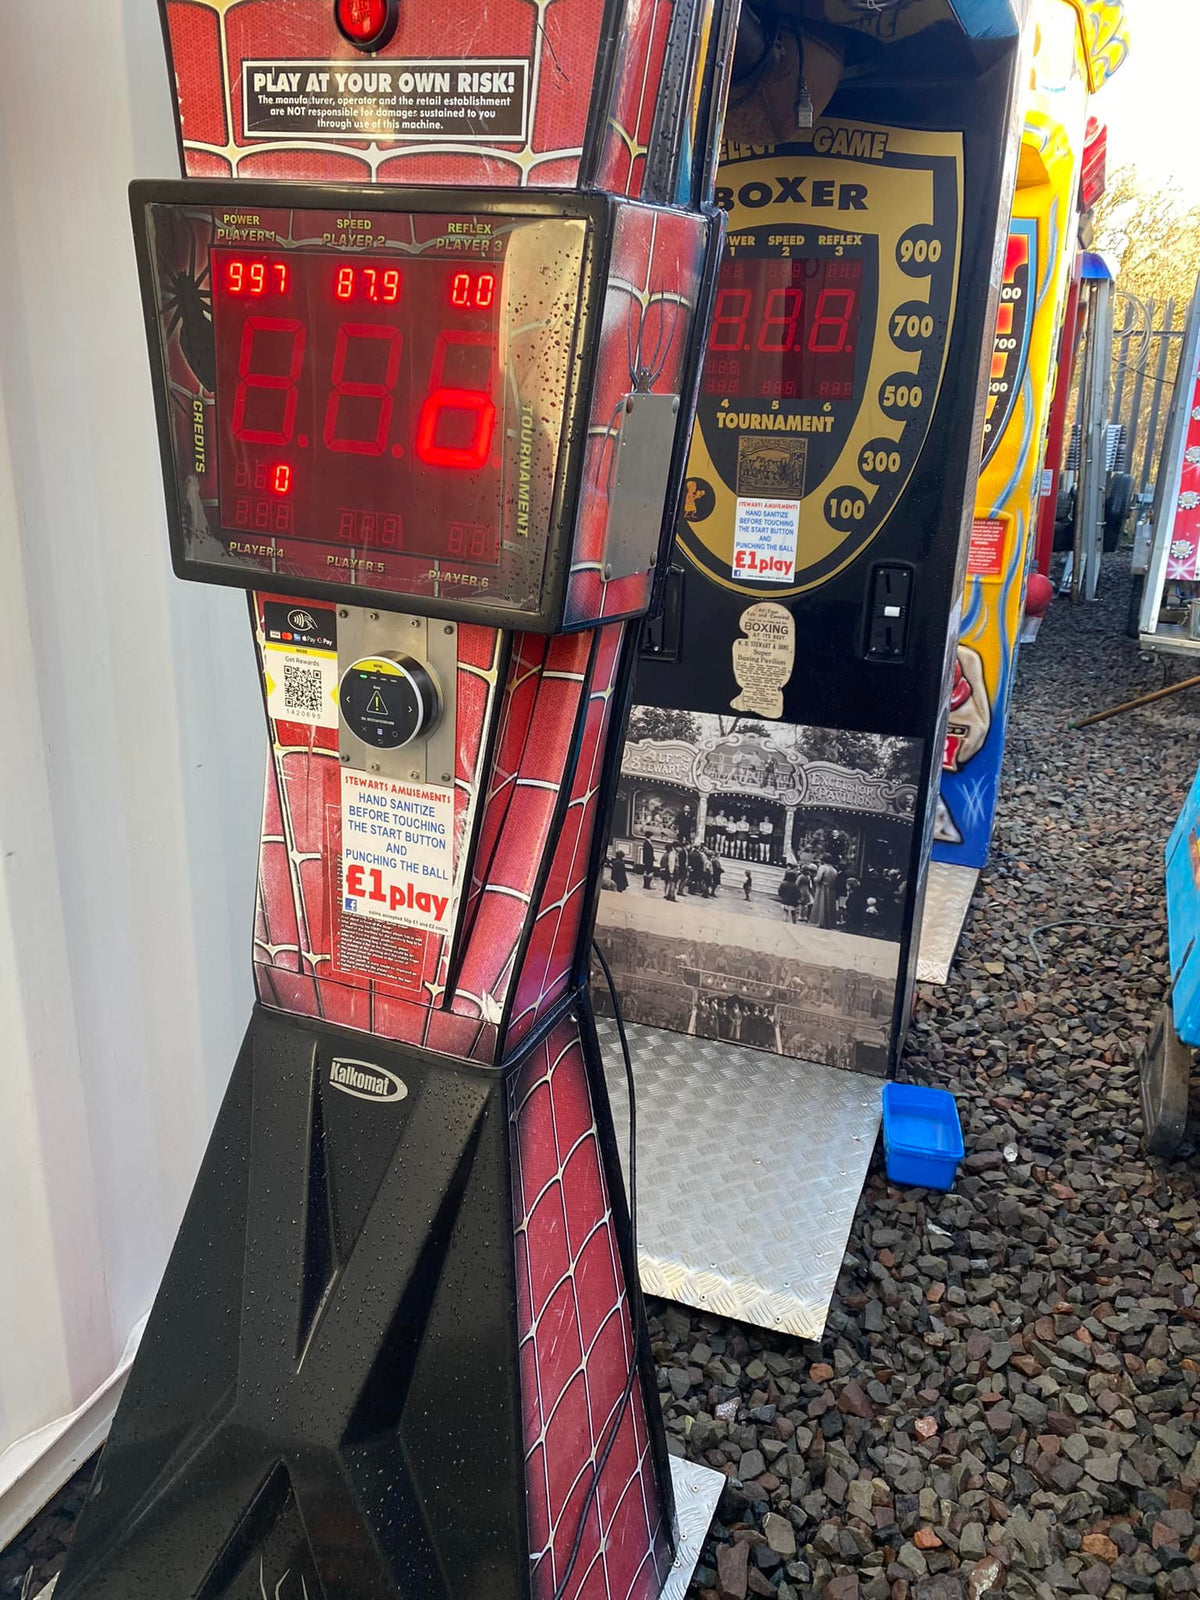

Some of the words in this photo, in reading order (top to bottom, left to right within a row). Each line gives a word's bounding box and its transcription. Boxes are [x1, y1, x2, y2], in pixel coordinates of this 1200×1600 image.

[253, 73, 301, 92] PLAY
[305, 73, 329, 92] AT
[335, 73, 392, 93] YOUR
[398, 73, 450, 93] OWN
[458, 72, 515, 93] RISK!
[258, 95, 273, 105] The
[337, 96, 377, 106] operator
[379, 96, 397, 105] and
[400, 96, 414, 105] the
[416, 96, 441, 106] retail
[443, 96, 511, 106] establishment
[270, 108, 285, 116] are
[287, 107, 306, 116] NOT
[308, 107, 358, 119] responsible
[360, 108, 374, 117] for
[376, 108, 417, 119] damages
[420, 108, 465, 118] sustained
[467, 109, 476, 118] to
[479, 112, 496, 120] you
[317, 119, 352, 130] through
[371, 119, 381, 128] of
[383, 120, 399, 129] this
[402, 120, 444, 130] machine.
[812, 127, 889, 160] GAME
[715, 177, 868, 212] BOXER
[223, 214, 260, 225] POWER
[336, 218, 372, 230] SPEED
[448, 223, 492, 235] REFLEX
[217, 229, 266, 242] PLAYER
[269, 231, 276, 242] 1
[322, 233, 373, 247] PLAYER
[377, 235, 386, 248] 2
[435, 238, 489, 252] PLAYER
[494, 240, 502, 252] 3
[725, 235, 755, 246] WER
[768, 235, 805, 246] SPEED
[818, 235, 862, 246] REFLEX
[730, 247, 736, 256] 1
[781, 247, 790, 256] 2
[835, 247, 844, 256] 3
[900, 239, 942, 263] 900
[228, 262, 287, 293] 997
[336, 267, 399, 301] 87.9
[452, 273, 494, 307] 0.0
[1001, 287, 1022, 300] 00
[893, 315, 934, 338] 700
[721, 399, 729, 408] 4
[771, 400, 780, 410] 5
[822, 402, 832, 412] 6
[882, 386, 923, 408] 500
[716, 411, 834, 433] TOURNAMENT
[193, 400, 206, 474] CREDITS
[517, 404, 533, 538] TOURNAMENT
[862, 451, 900, 472] 300
[274, 465, 290, 492] 0
[829, 498, 865, 520] 100
[764, 519, 794, 527] TOUCHING
[229, 542, 274, 557] PLAYER
[276, 548, 285, 558] 4
[736, 542, 765, 550] PUNCHING
[326, 555, 374, 571] PLAYER
[377, 563, 385, 573] 5
[428, 570, 479, 586] PLAYER
[481, 577, 489, 588] 6
[745, 621, 789, 635] BOXING
[284, 656, 295, 664] Get
[296, 657, 319, 667] Rewards
[345, 776, 388, 791] STEWARTS
[391, 784, 451, 804] AMUSEMENTS
[359, 792, 387, 807] HAND
[390, 799, 436, 818] SANITIZE
[349, 805, 390, 823] BEFORE
[392, 813, 446, 835] TOUCHING
[348, 819, 368, 833] THE
[370, 824, 402, 841] START
[405, 832, 446, 850] BUTTON
[386, 842, 407, 856] AND
[345, 848, 397, 869] PUNCHING
[400, 859, 419, 874] THE
[422, 865, 449, 881] BALL
[330, 1062, 389, 1095] Kalkomat
